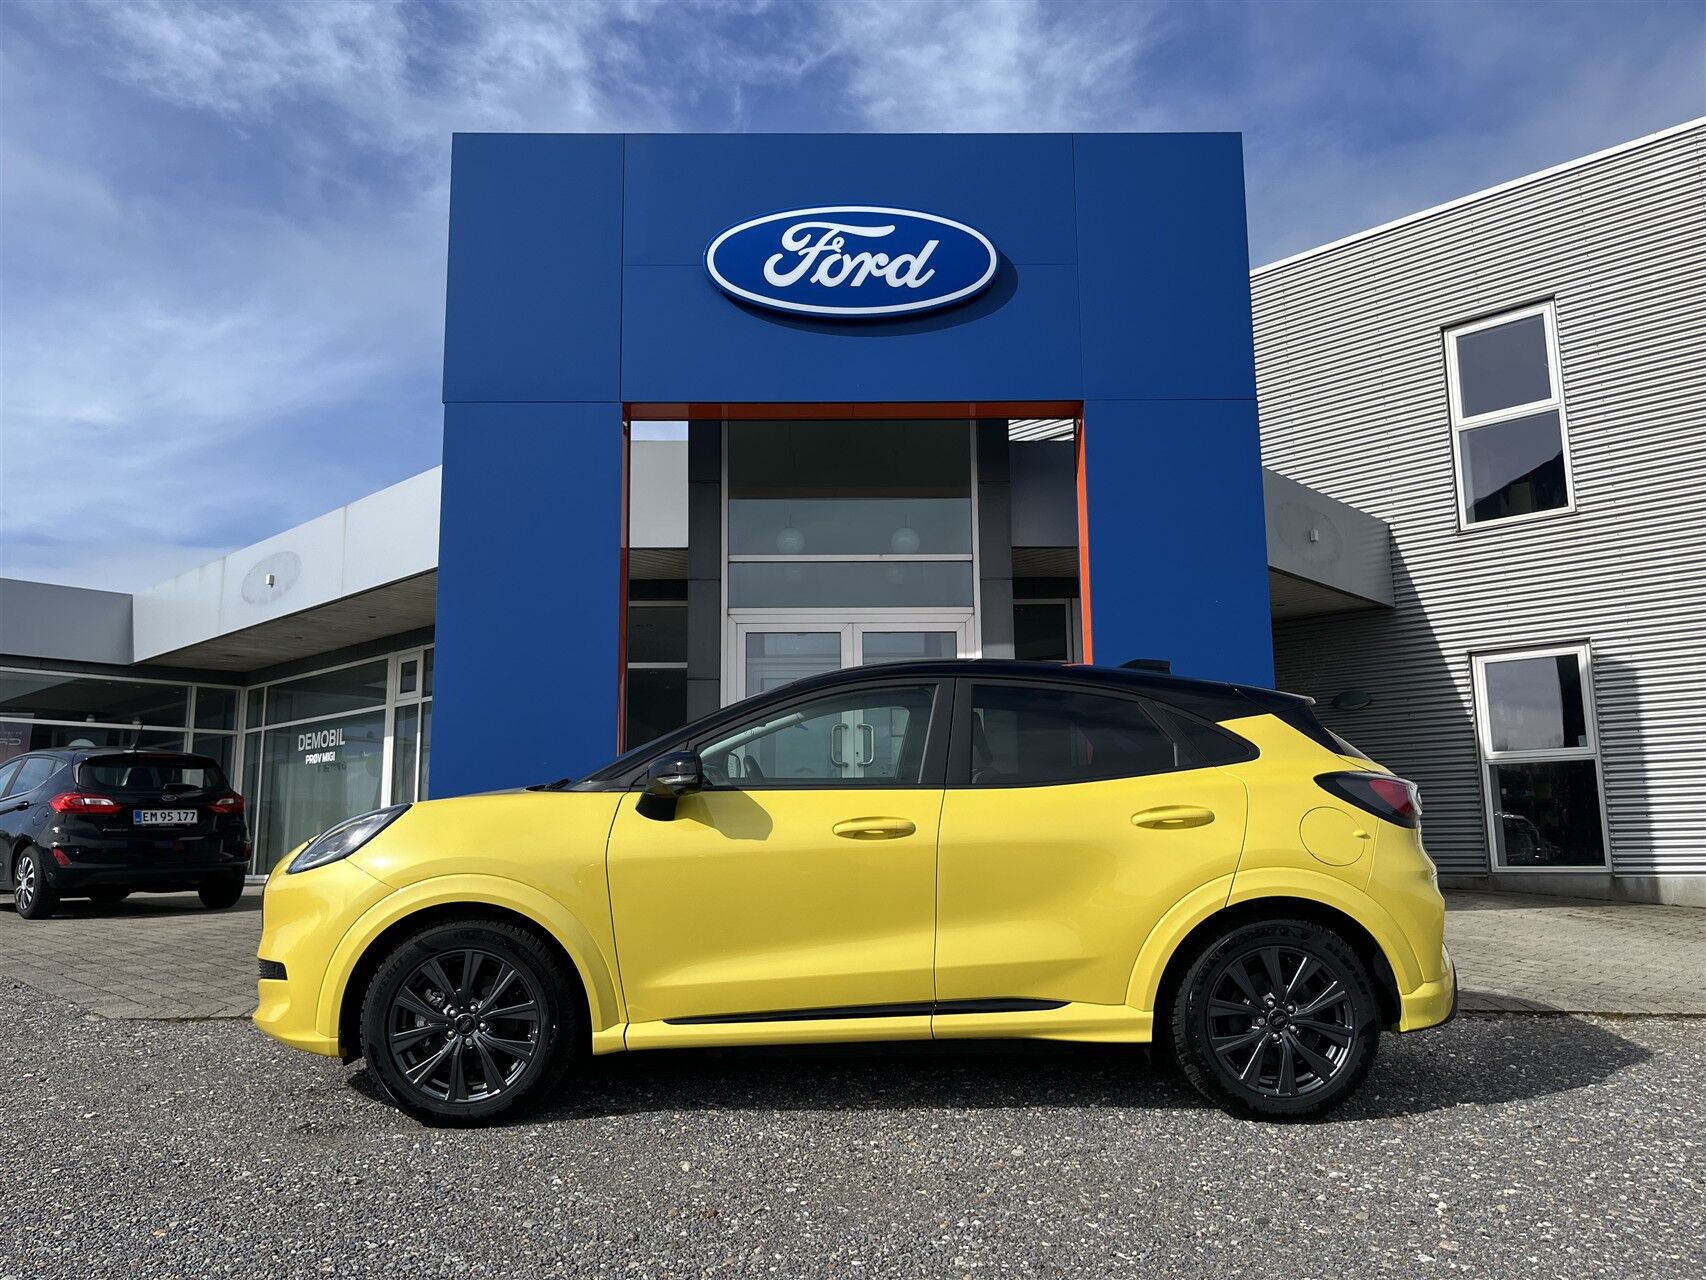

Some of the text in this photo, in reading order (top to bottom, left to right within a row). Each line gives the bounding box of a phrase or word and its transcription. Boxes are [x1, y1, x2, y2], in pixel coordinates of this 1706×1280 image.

[764, 222, 940, 288] Ford
[298, 728, 345, 751] DEMOBIL
[143, 812, 158, 821] EM
[160, 812, 173, 821] 95
[177, 812, 195, 821] 177
